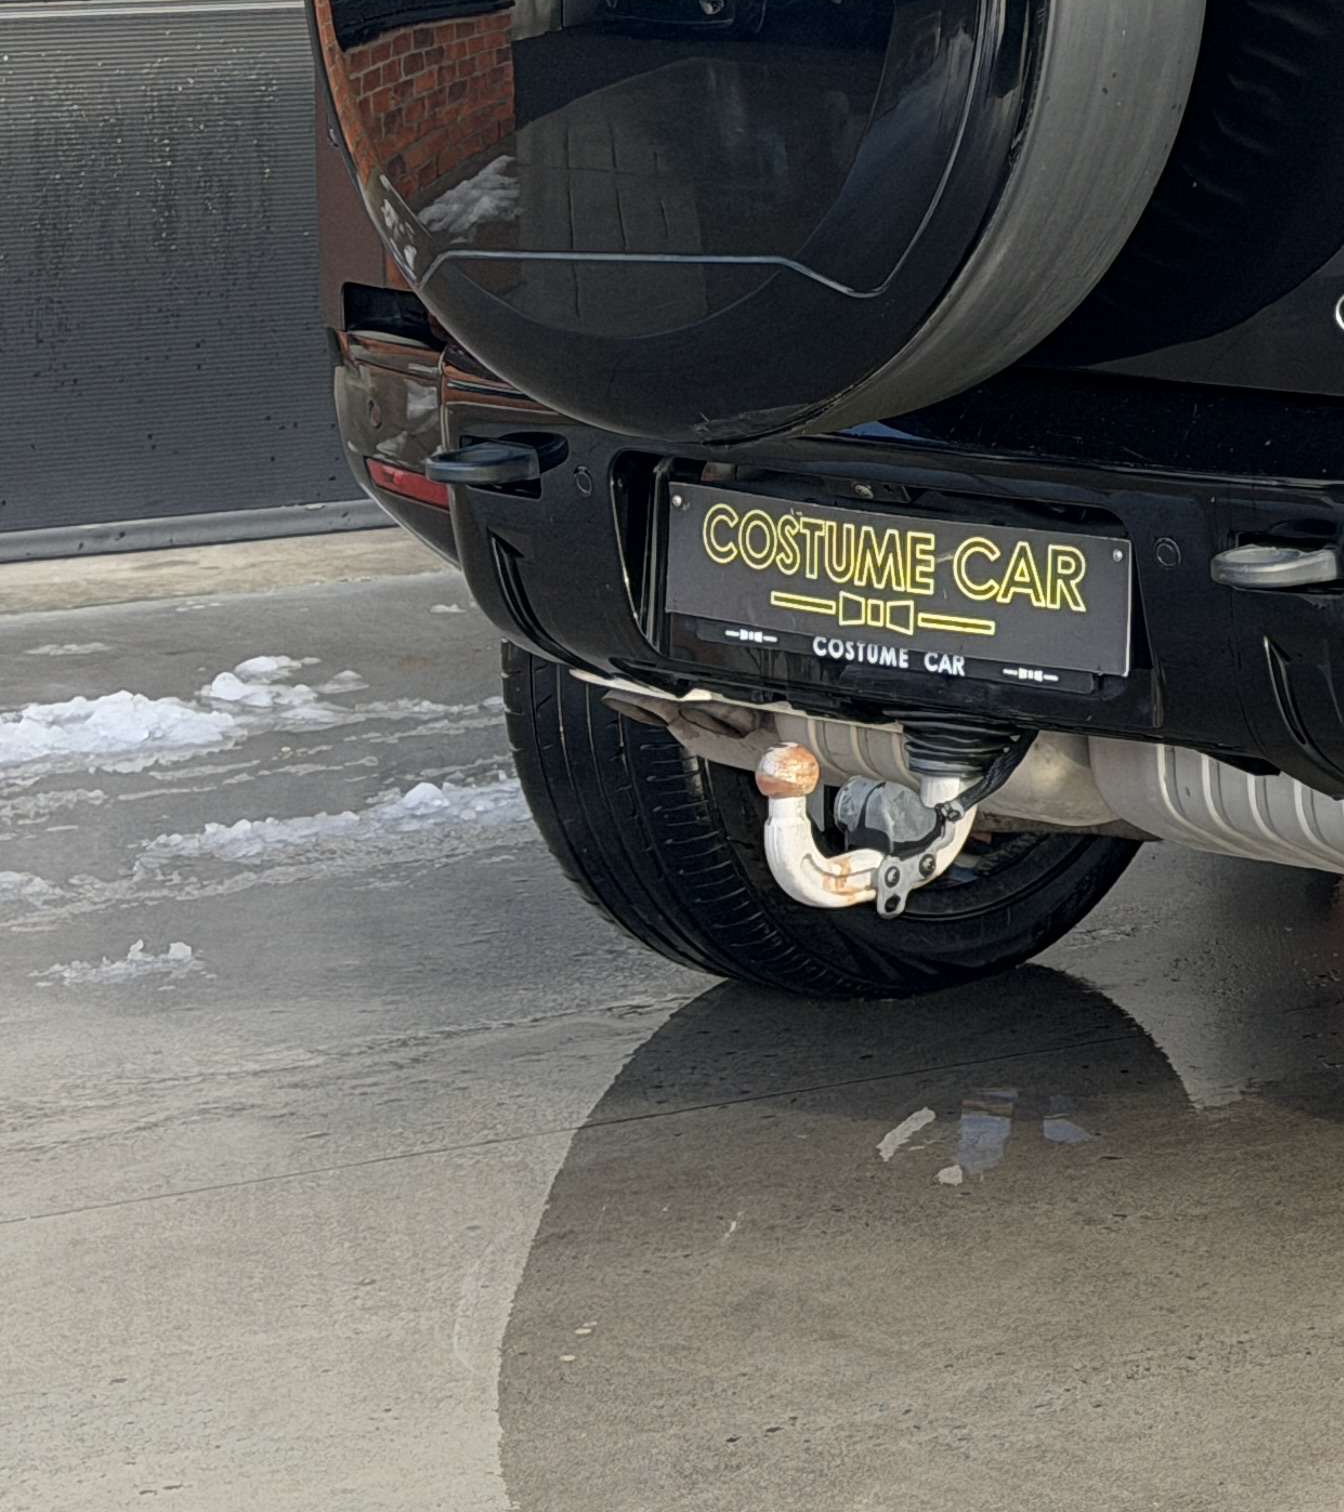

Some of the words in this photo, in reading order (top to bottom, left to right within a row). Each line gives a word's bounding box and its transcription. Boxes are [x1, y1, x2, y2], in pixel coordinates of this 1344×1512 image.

[703, 502, 935, 595] COSTUME
[953, 536, 1086, 612] CAR
[812, 636, 910, 669] COSTUME
[924, 652, 966, 677] CAR
